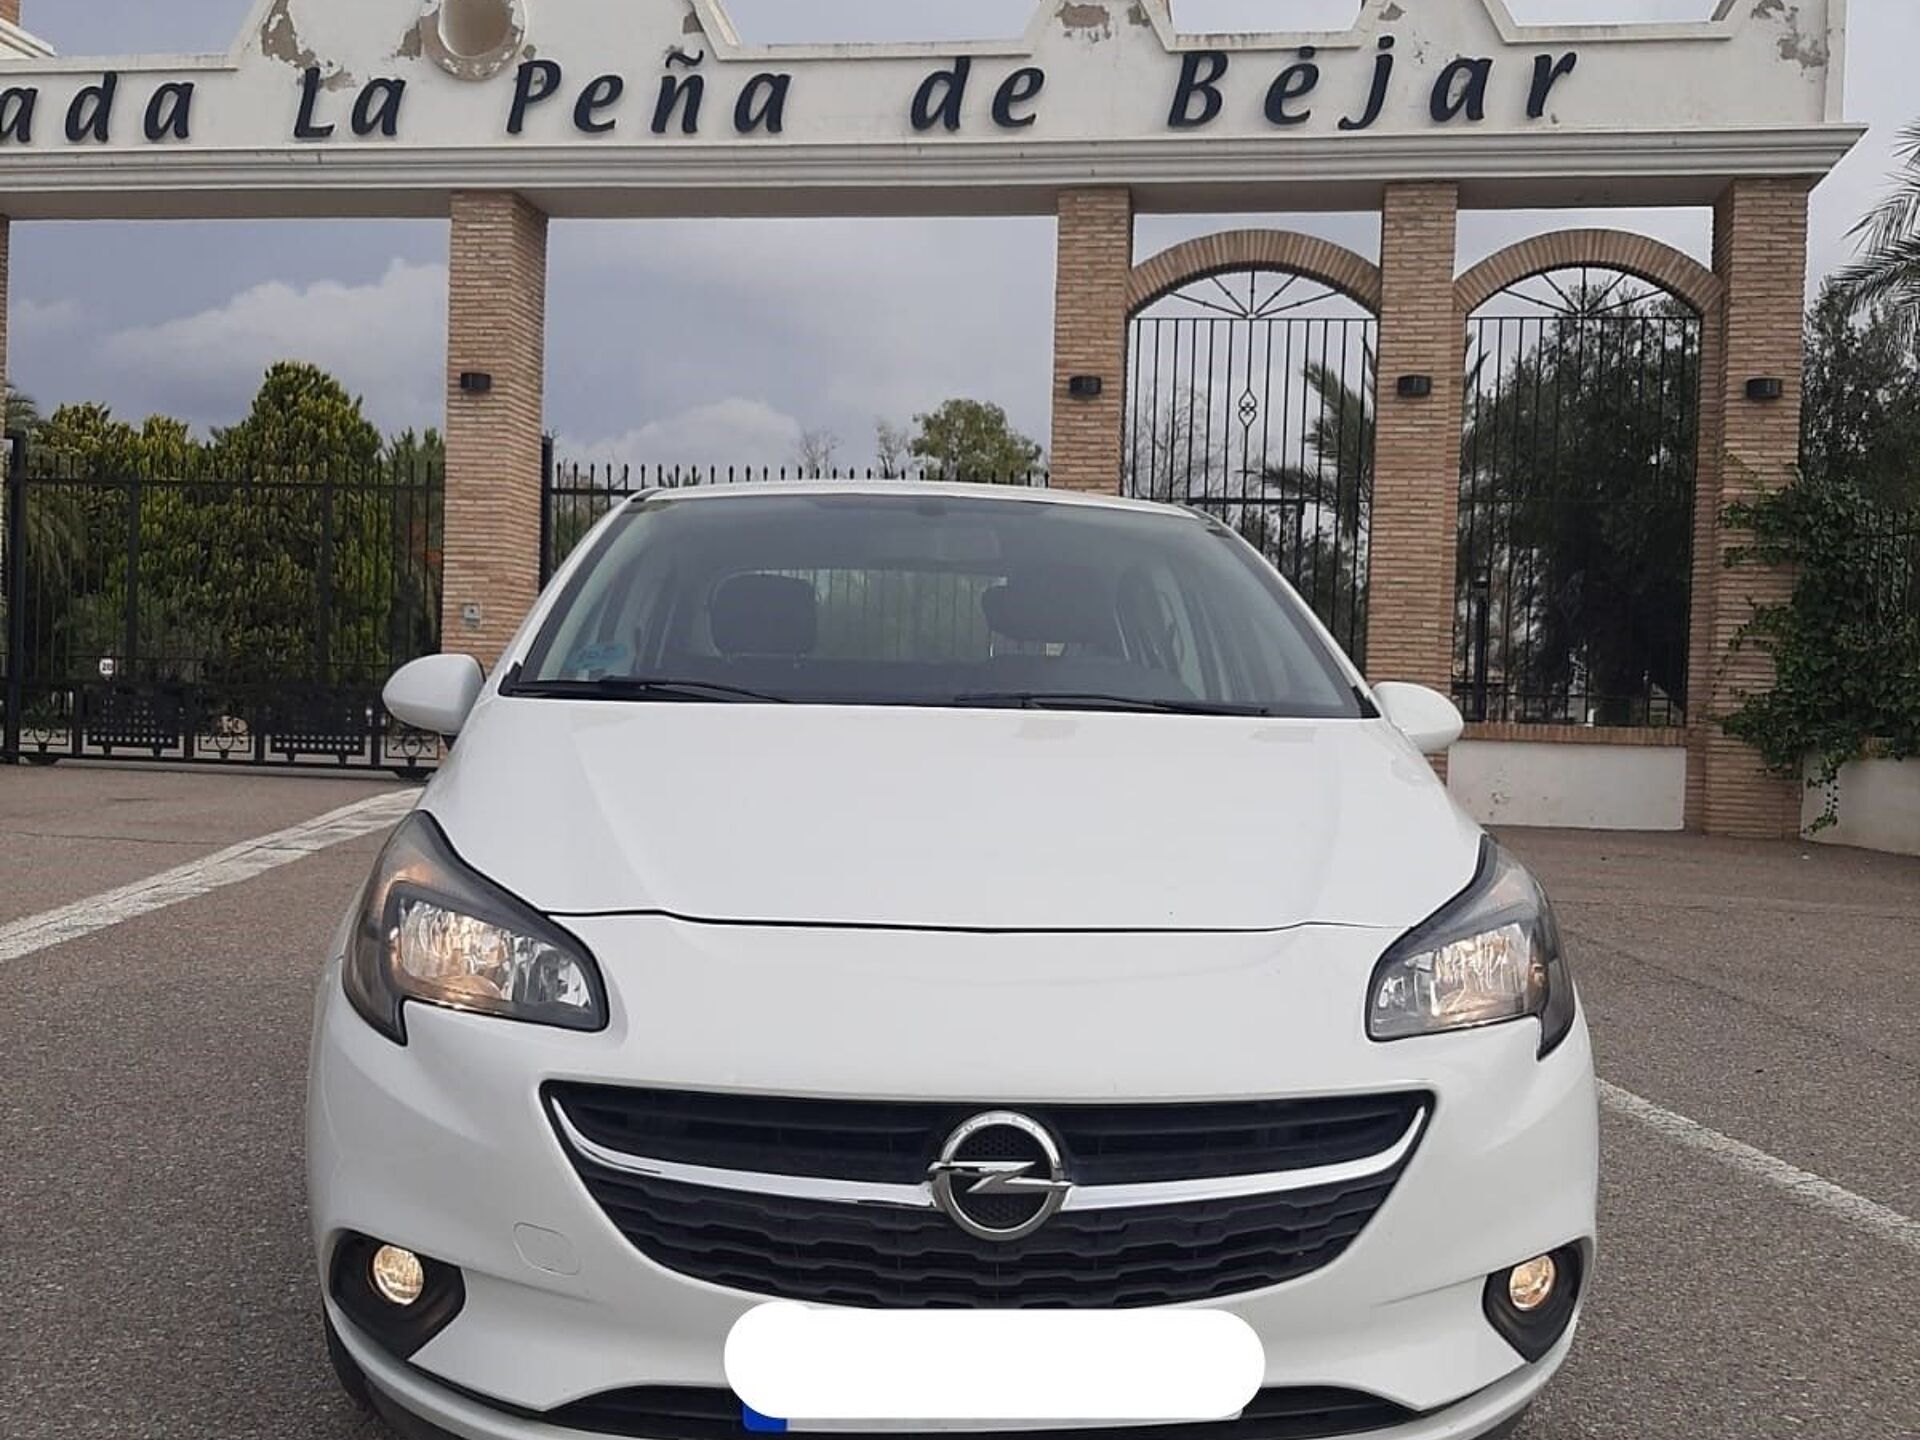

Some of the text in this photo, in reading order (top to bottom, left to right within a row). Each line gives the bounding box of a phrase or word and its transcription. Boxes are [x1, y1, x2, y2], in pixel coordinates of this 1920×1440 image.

[0, 36, 1577, 143] ada La Peña de Béjar
